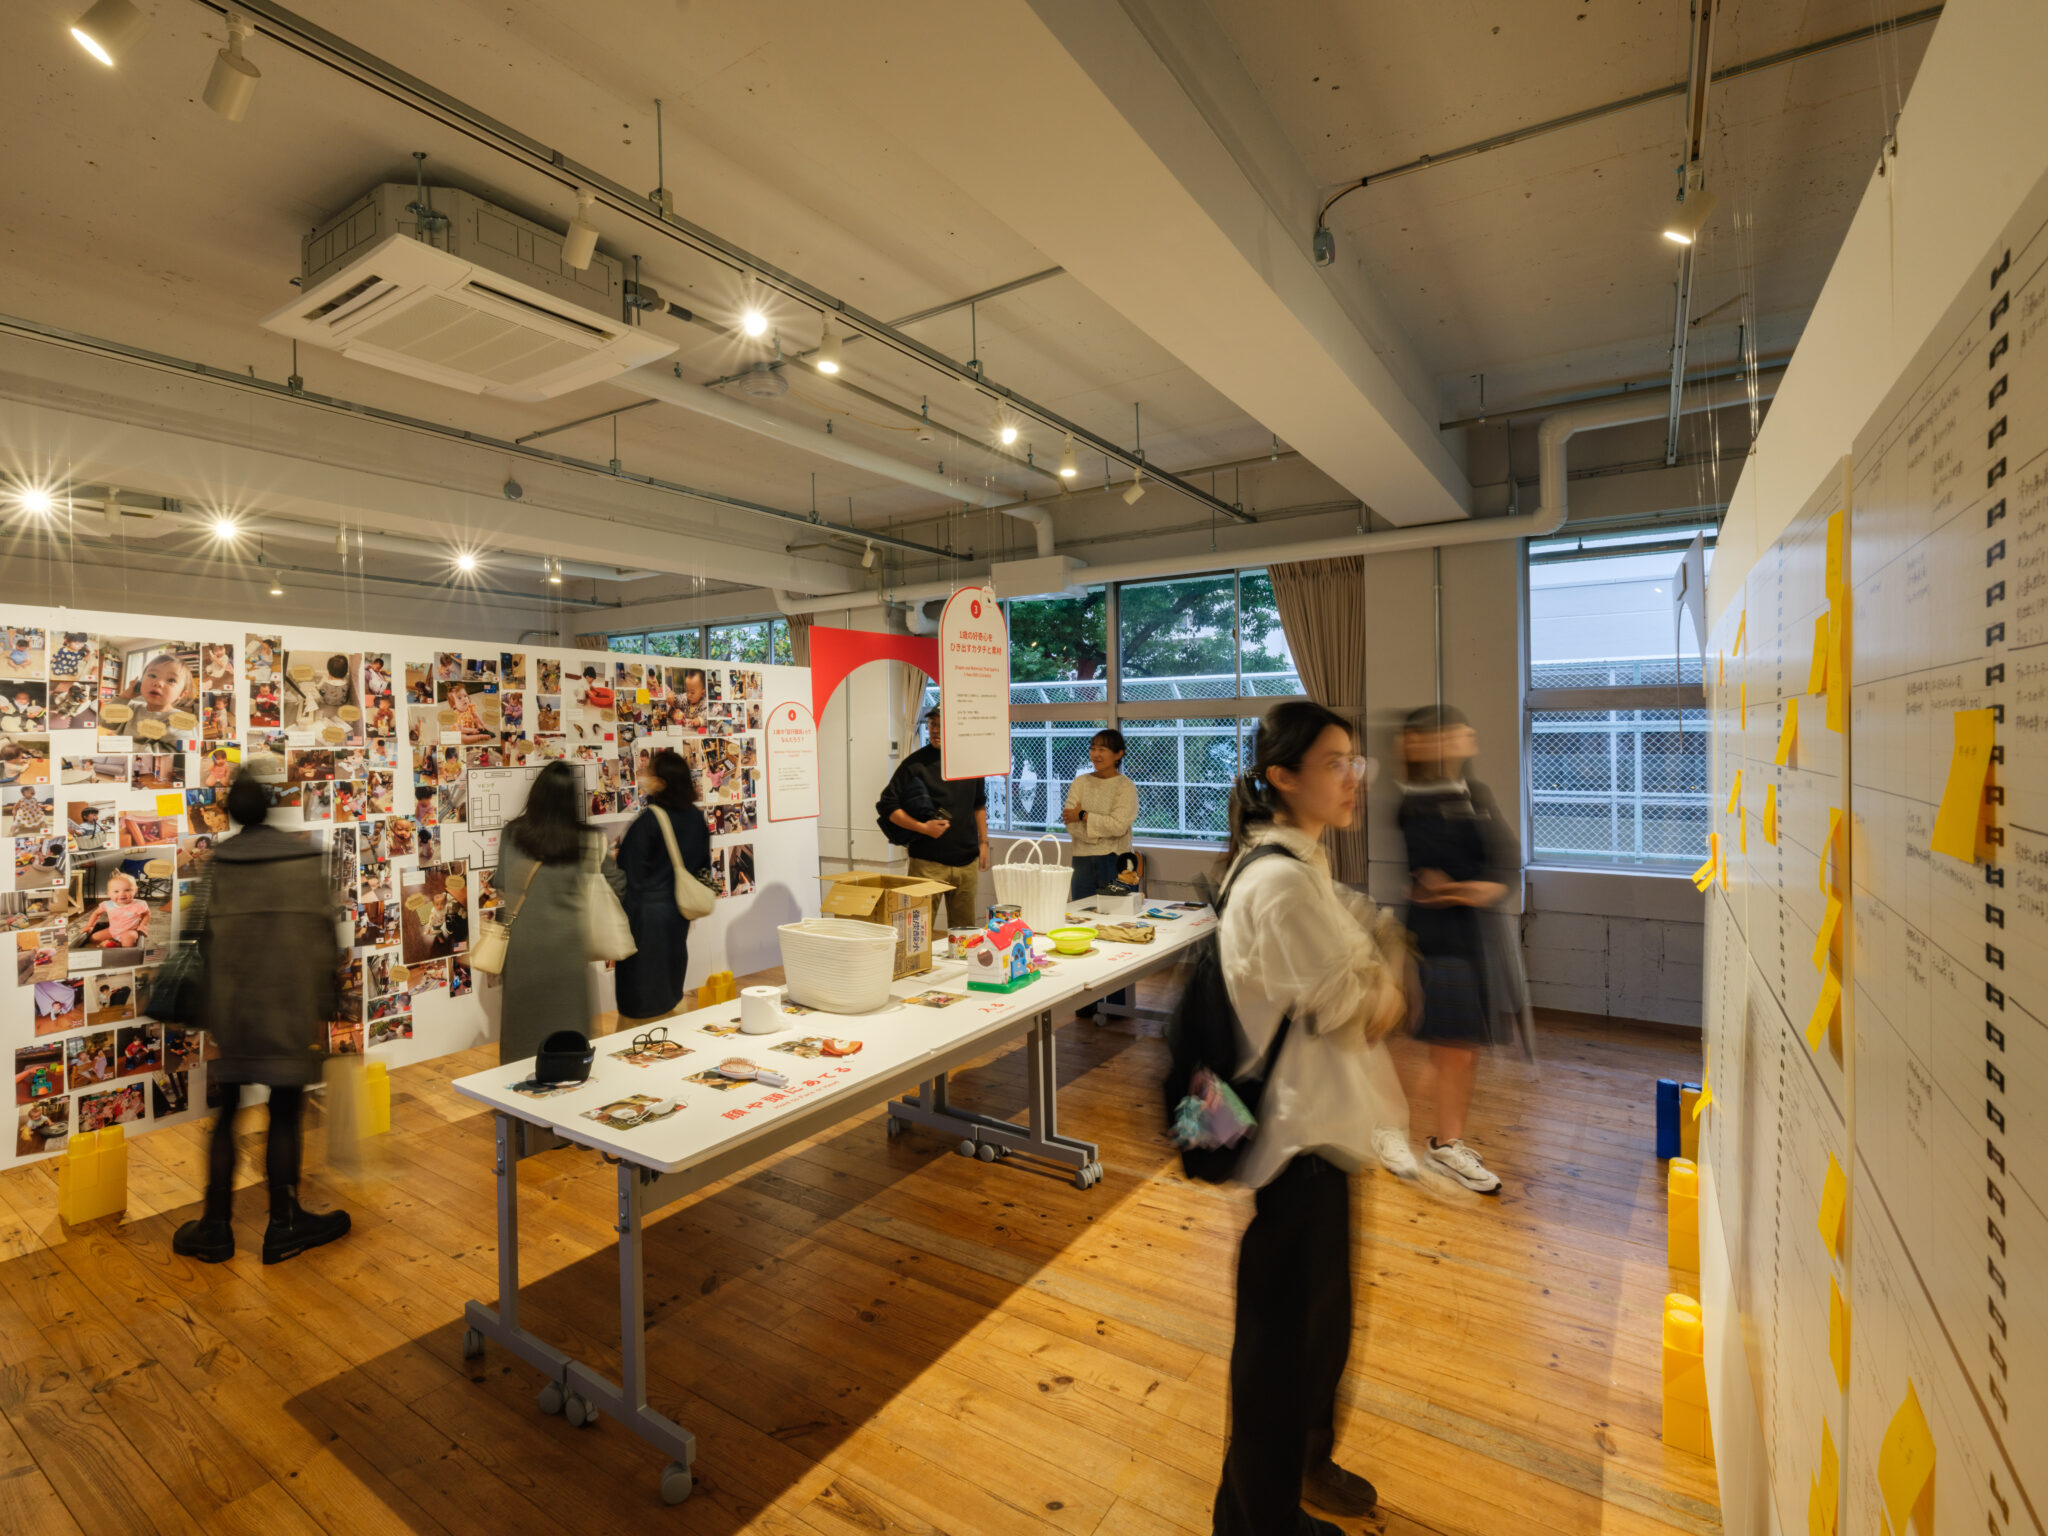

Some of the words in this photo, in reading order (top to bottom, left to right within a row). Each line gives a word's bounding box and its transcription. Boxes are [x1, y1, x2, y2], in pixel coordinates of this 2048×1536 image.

[721, 1067, 851, 1120] 顔や頭にあてる
